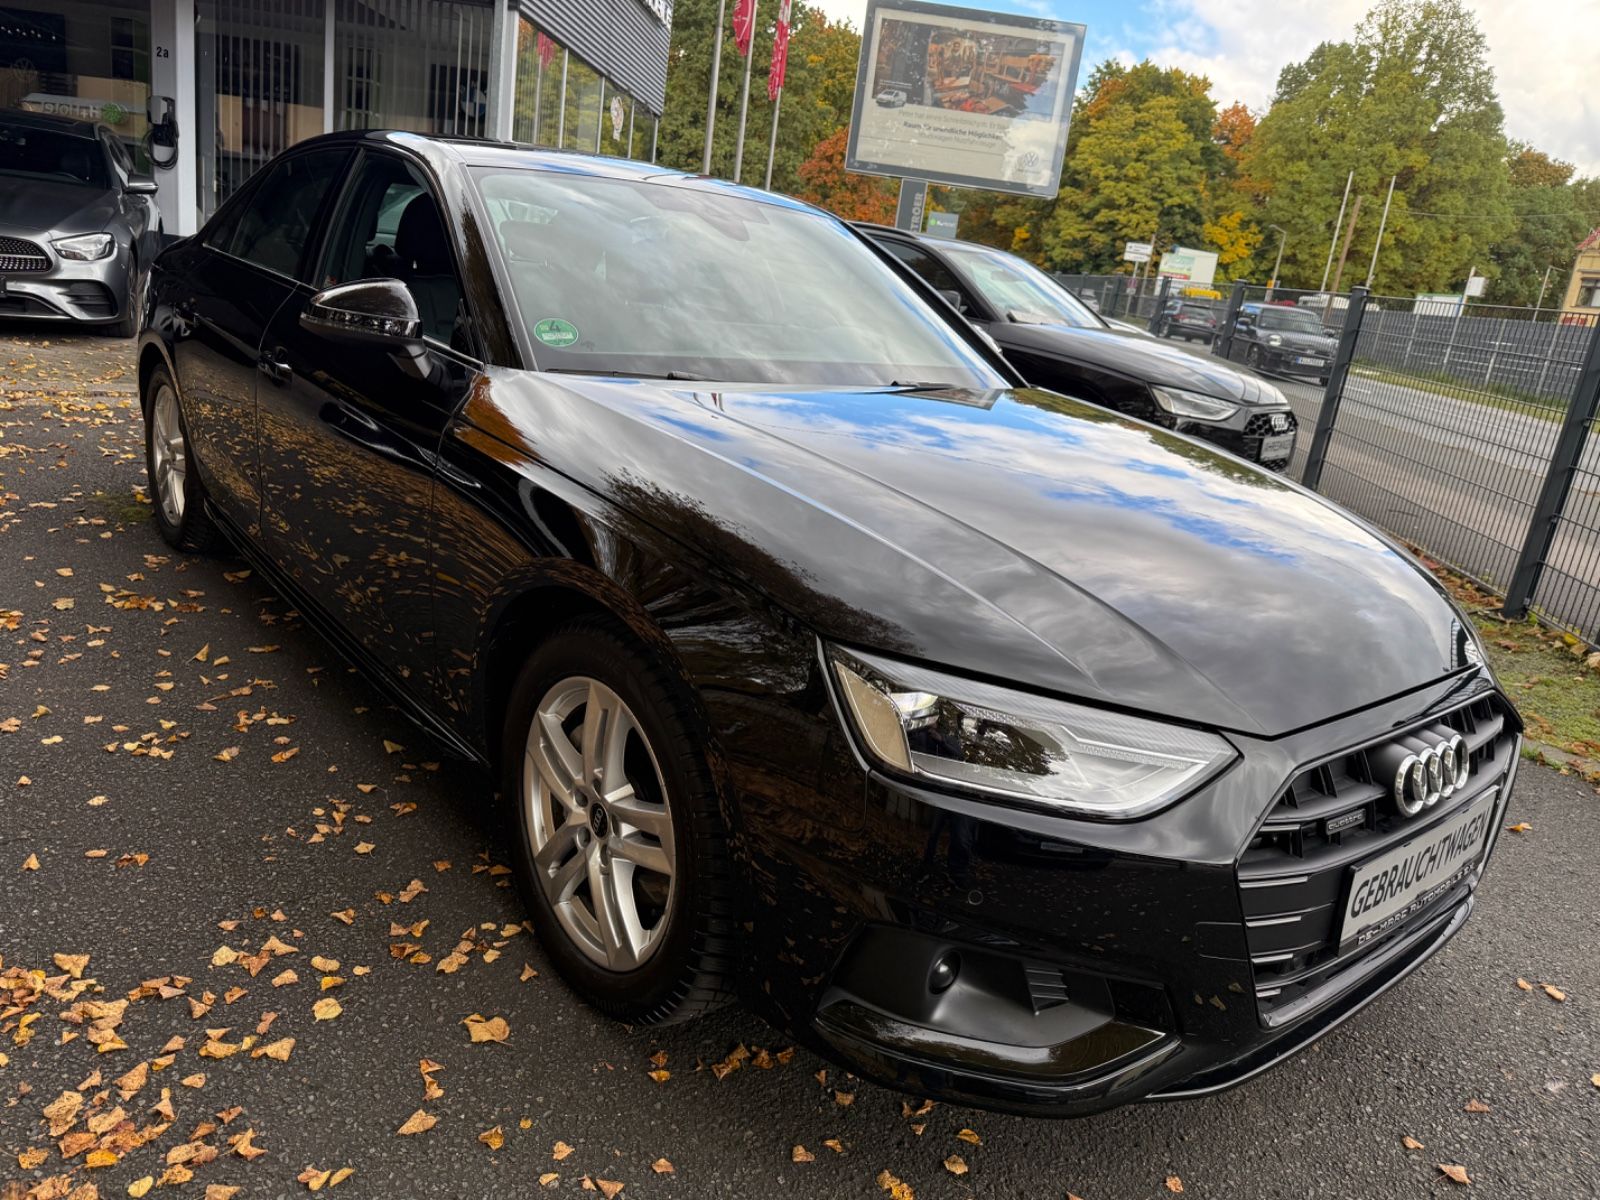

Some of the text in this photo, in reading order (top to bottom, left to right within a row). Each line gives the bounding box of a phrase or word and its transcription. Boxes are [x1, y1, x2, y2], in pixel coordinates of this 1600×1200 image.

[156, 46, 169, 58] 2a
[1328, 812, 1362, 830] quattro
[1350, 807, 1490, 918] GEBRAUCHTWAGEN
